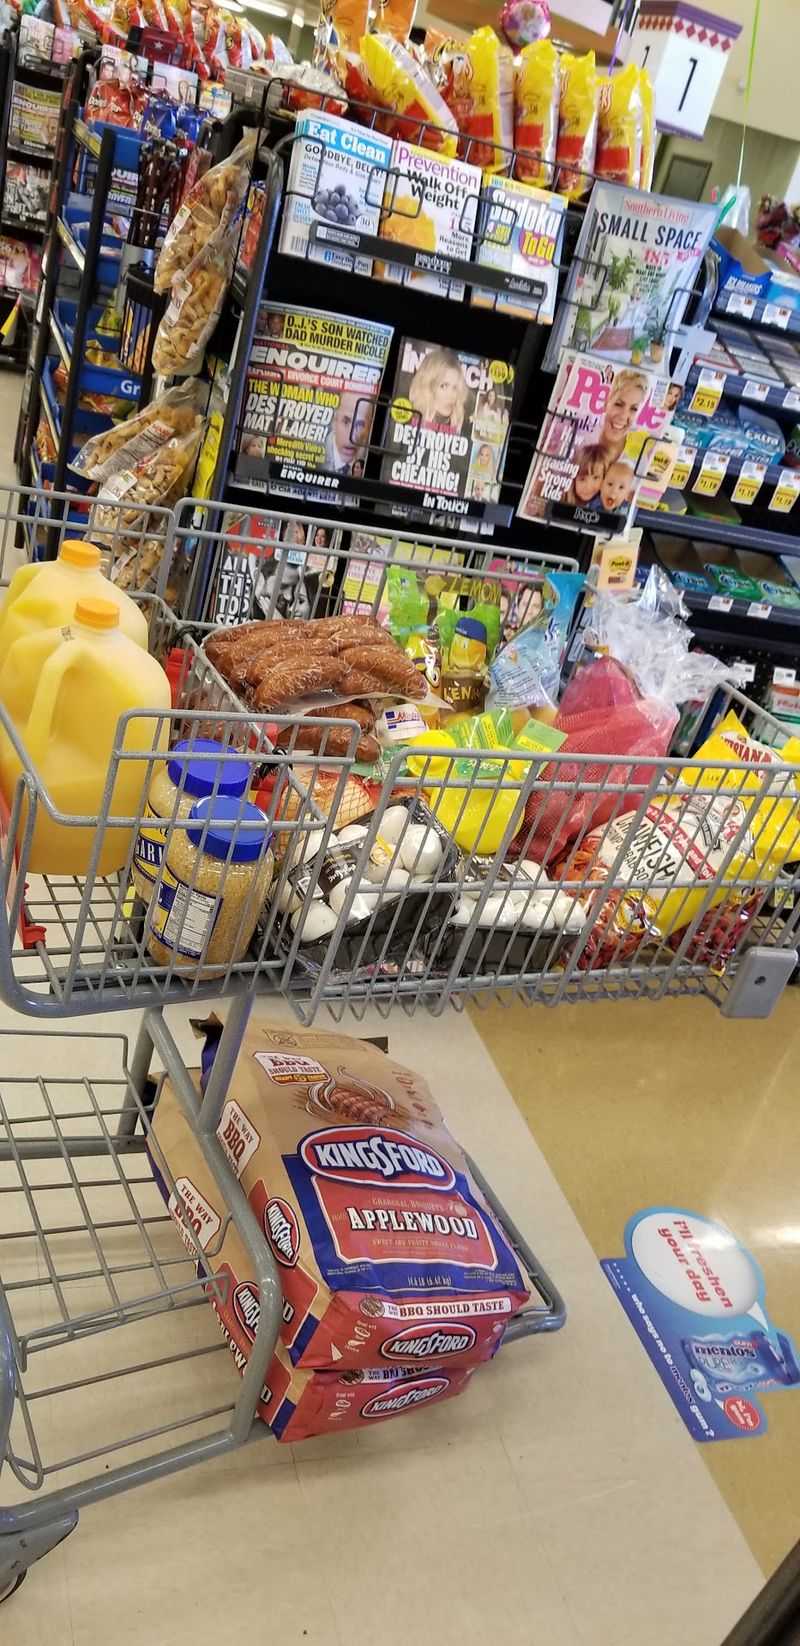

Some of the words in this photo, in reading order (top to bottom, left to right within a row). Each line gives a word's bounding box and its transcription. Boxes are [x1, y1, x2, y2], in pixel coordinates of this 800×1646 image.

[678, 57, 698, 112] 1
[308, 121, 337, 145] Eat
[340, 132, 386, 163] Clean
[398, 147, 478, 188] Prevention
[407, 169, 441, 191] Walk
[445, 182, 466, 198] Off
[411, 183, 460, 210] Weight
[489, 189, 562, 238] Sudoku
[599, 213, 648, 242] SMALL
[655, 225, 702, 250] SPACE
[285, 328, 307, 342] DAD
[309, 331, 354, 352] MURDER
[287, 316, 318, 331] O.J.'S
[320, 320, 344, 336] SON
[346, 324, 389, 347] WATCHED
[251, 345, 382, 385] ENQUIRER
[249, 379, 269, 393] THE
[270, 382, 314, 402] WOMAN
[315, 391, 341, 408] WHO
[566, 367, 666, 430] Pele
[246, 394, 334, 426] DESTROYED
[284, 420, 329, 443] LAUER!
[393, 423, 469, 457] DESTROYED
[391, 461, 460, 492] CHEATING!
[428, 448, 451, 473] HIS
[280, 469, 341, 489] ENQUIRER
[538, 471, 573, 493] Strong
[540, 482, 563, 501] Kids
[436, 496, 469, 515] TOUCH
[223, 1120, 246, 1163] BBQ
[229, 1108, 241, 1123] THE
[241, 1124, 255, 1145] WAY
[314, 1136, 445, 1176] KINGSFORD
[181, 1184, 195, 1204] THE
[195, 1203, 214, 1225] WAY
[267, 1202, 294, 1260] KINGSFORD
[346, 1207, 478, 1240] APPLEWOOD
[673, 1219, 693, 1239] I'll
[658, 1227, 690, 1265] your
[686, 1269, 711, 1302] day
[237, 1287, 261, 1334] KINGS
[399, 1306, 424, 1317] BBQ
[427, 1303, 470, 1316] SHOULD
[472, 1300, 505, 1313] TASTE
[391, 1332, 469, 1357] KINGSFORD
[631, 1293, 645, 1314] who
[643, 1314, 659, 1339] says
[656, 1339, 667, 1354] no
[664, 1354, 674, 1366] to
[694, 1344, 757, 1358] mentos
[371, 1385, 443, 1412] KINGSFORD
